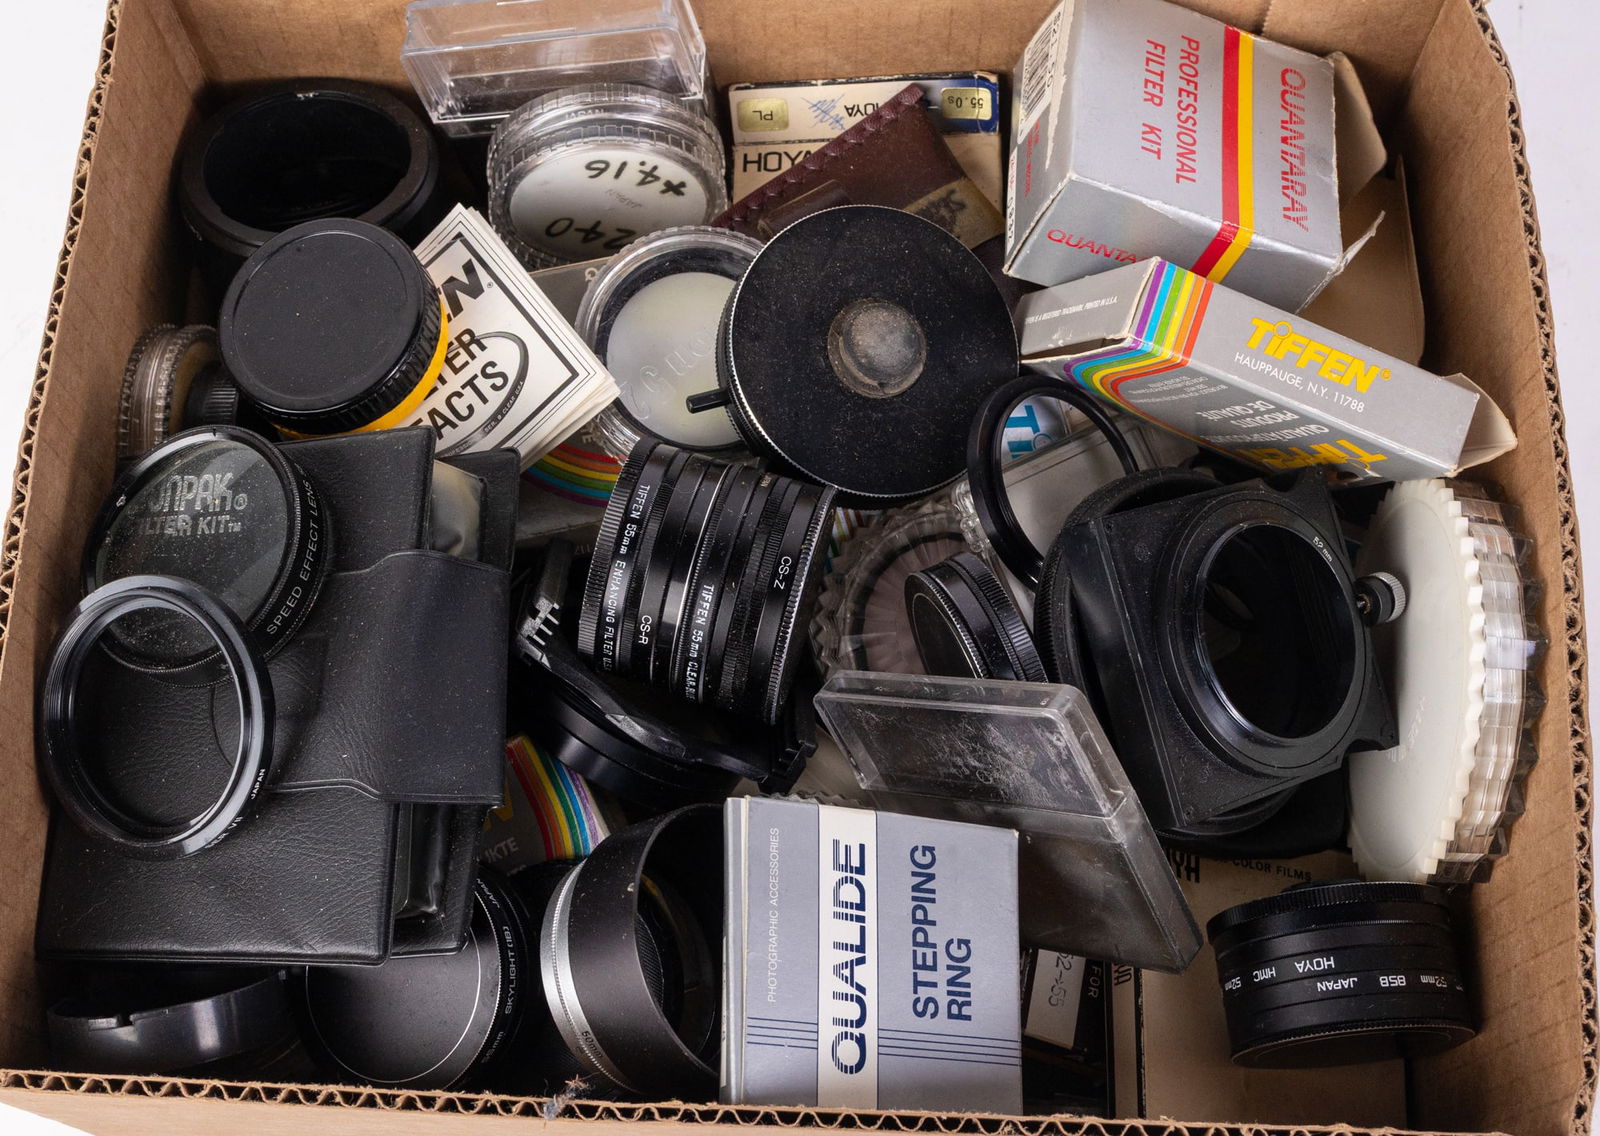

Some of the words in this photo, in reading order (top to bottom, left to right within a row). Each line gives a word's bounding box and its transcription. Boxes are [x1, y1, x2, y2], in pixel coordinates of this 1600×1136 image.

[1143, 39, 1166, 108] FILTER
[752, 110, 774, 121] PL
[1175, 35, 1200, 184] PROFESSIONAL
[1140, 122, 1162, 160] KIT
[1280, 67, 1309, 232] QUANTARAY
[1046, 229, 1148, 264] QUANTA
[410, 360, 508, 440] ACTS
[1234, 352, 1304, 390] HAUPPAUGE,
[1308, 384, 1329, 400] N.Y.
[1333, 392, 1365, 413] 11788
[302, 480, 320, 516] LENS
[634, 484, 650, 520] TIFFEN
[300, 523, 319, 582] EFFECT
[619, 523, 638, 556] 55mm
[605, 560, 627, 624] ENHANCING
[773, 556, 792, 590] CS-Z
[266, 586, 302, 635] SPEED
[696, 584, 714, 626] TIFFEN
[602, 626, 615, 656] FILTER
[638, 614, 652, 646] CS-R
[688, 628, 704, 658] 55mm
[768, 827, 780, 906] ACCESSORIES
[1232, 856, 1272, 874] COLOR
[1276, 862, 1313, 882] FILMS
[910, 844, 940, 1019] STEPPING
[767, 910, 780, 1003] PHOTOGRAPHIC
[831, 838, 868, 1075] QUALIDE
[1253, 966, 1277, 982] HMC
[1294, 956, 1335, 974] HOYA
[504, 954, 518, 1015] SKYLIGHT
[945, 938, 972, 1022] RING
[1316, 976, 1358, 992] JAPAN
[1379, 974, 1406, 988] 85B
